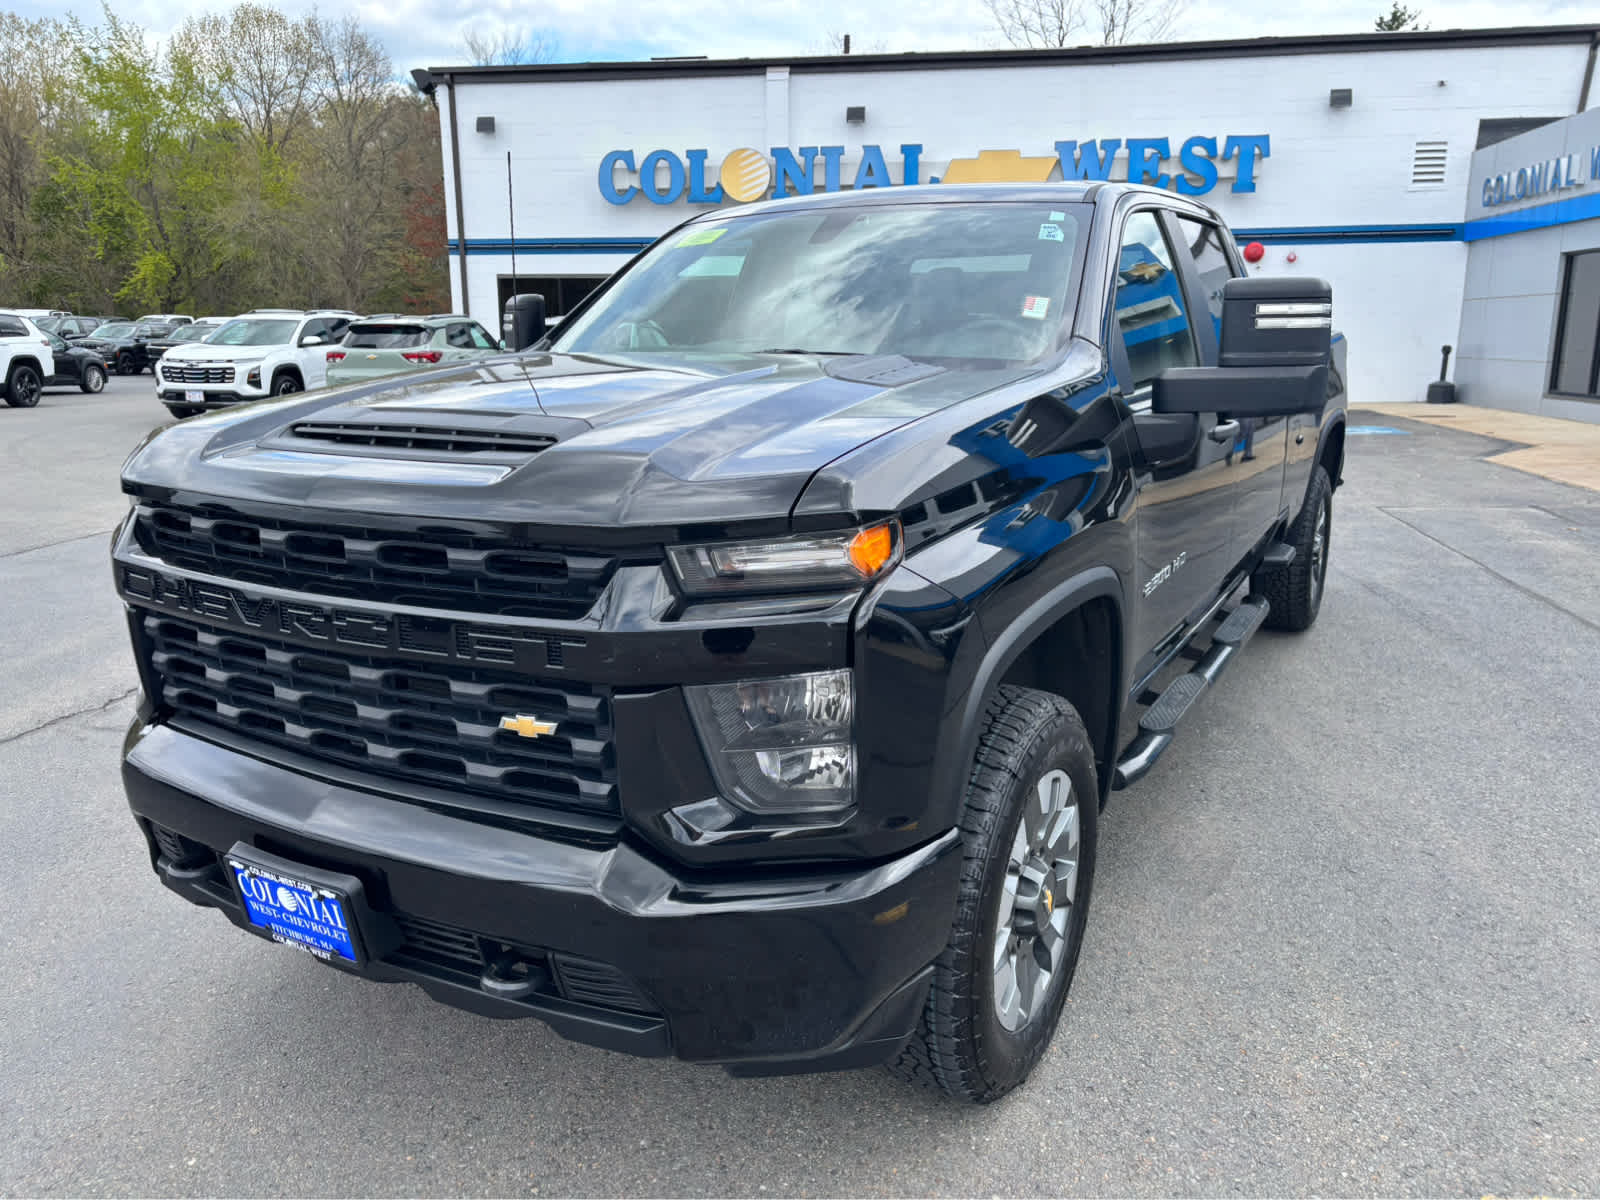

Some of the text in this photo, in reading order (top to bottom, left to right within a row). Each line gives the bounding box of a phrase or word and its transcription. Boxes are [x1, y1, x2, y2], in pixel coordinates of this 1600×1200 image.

[597, 134, 1270, 206] COLONIAL WEST
[1482, 153, 1577, 207] COLONIAL
[123, 566, 588, 670] CHEVROLET
[237, 872, 348, 931] COLONIAL
[281, 912, 348, 943] CHEVROLET
